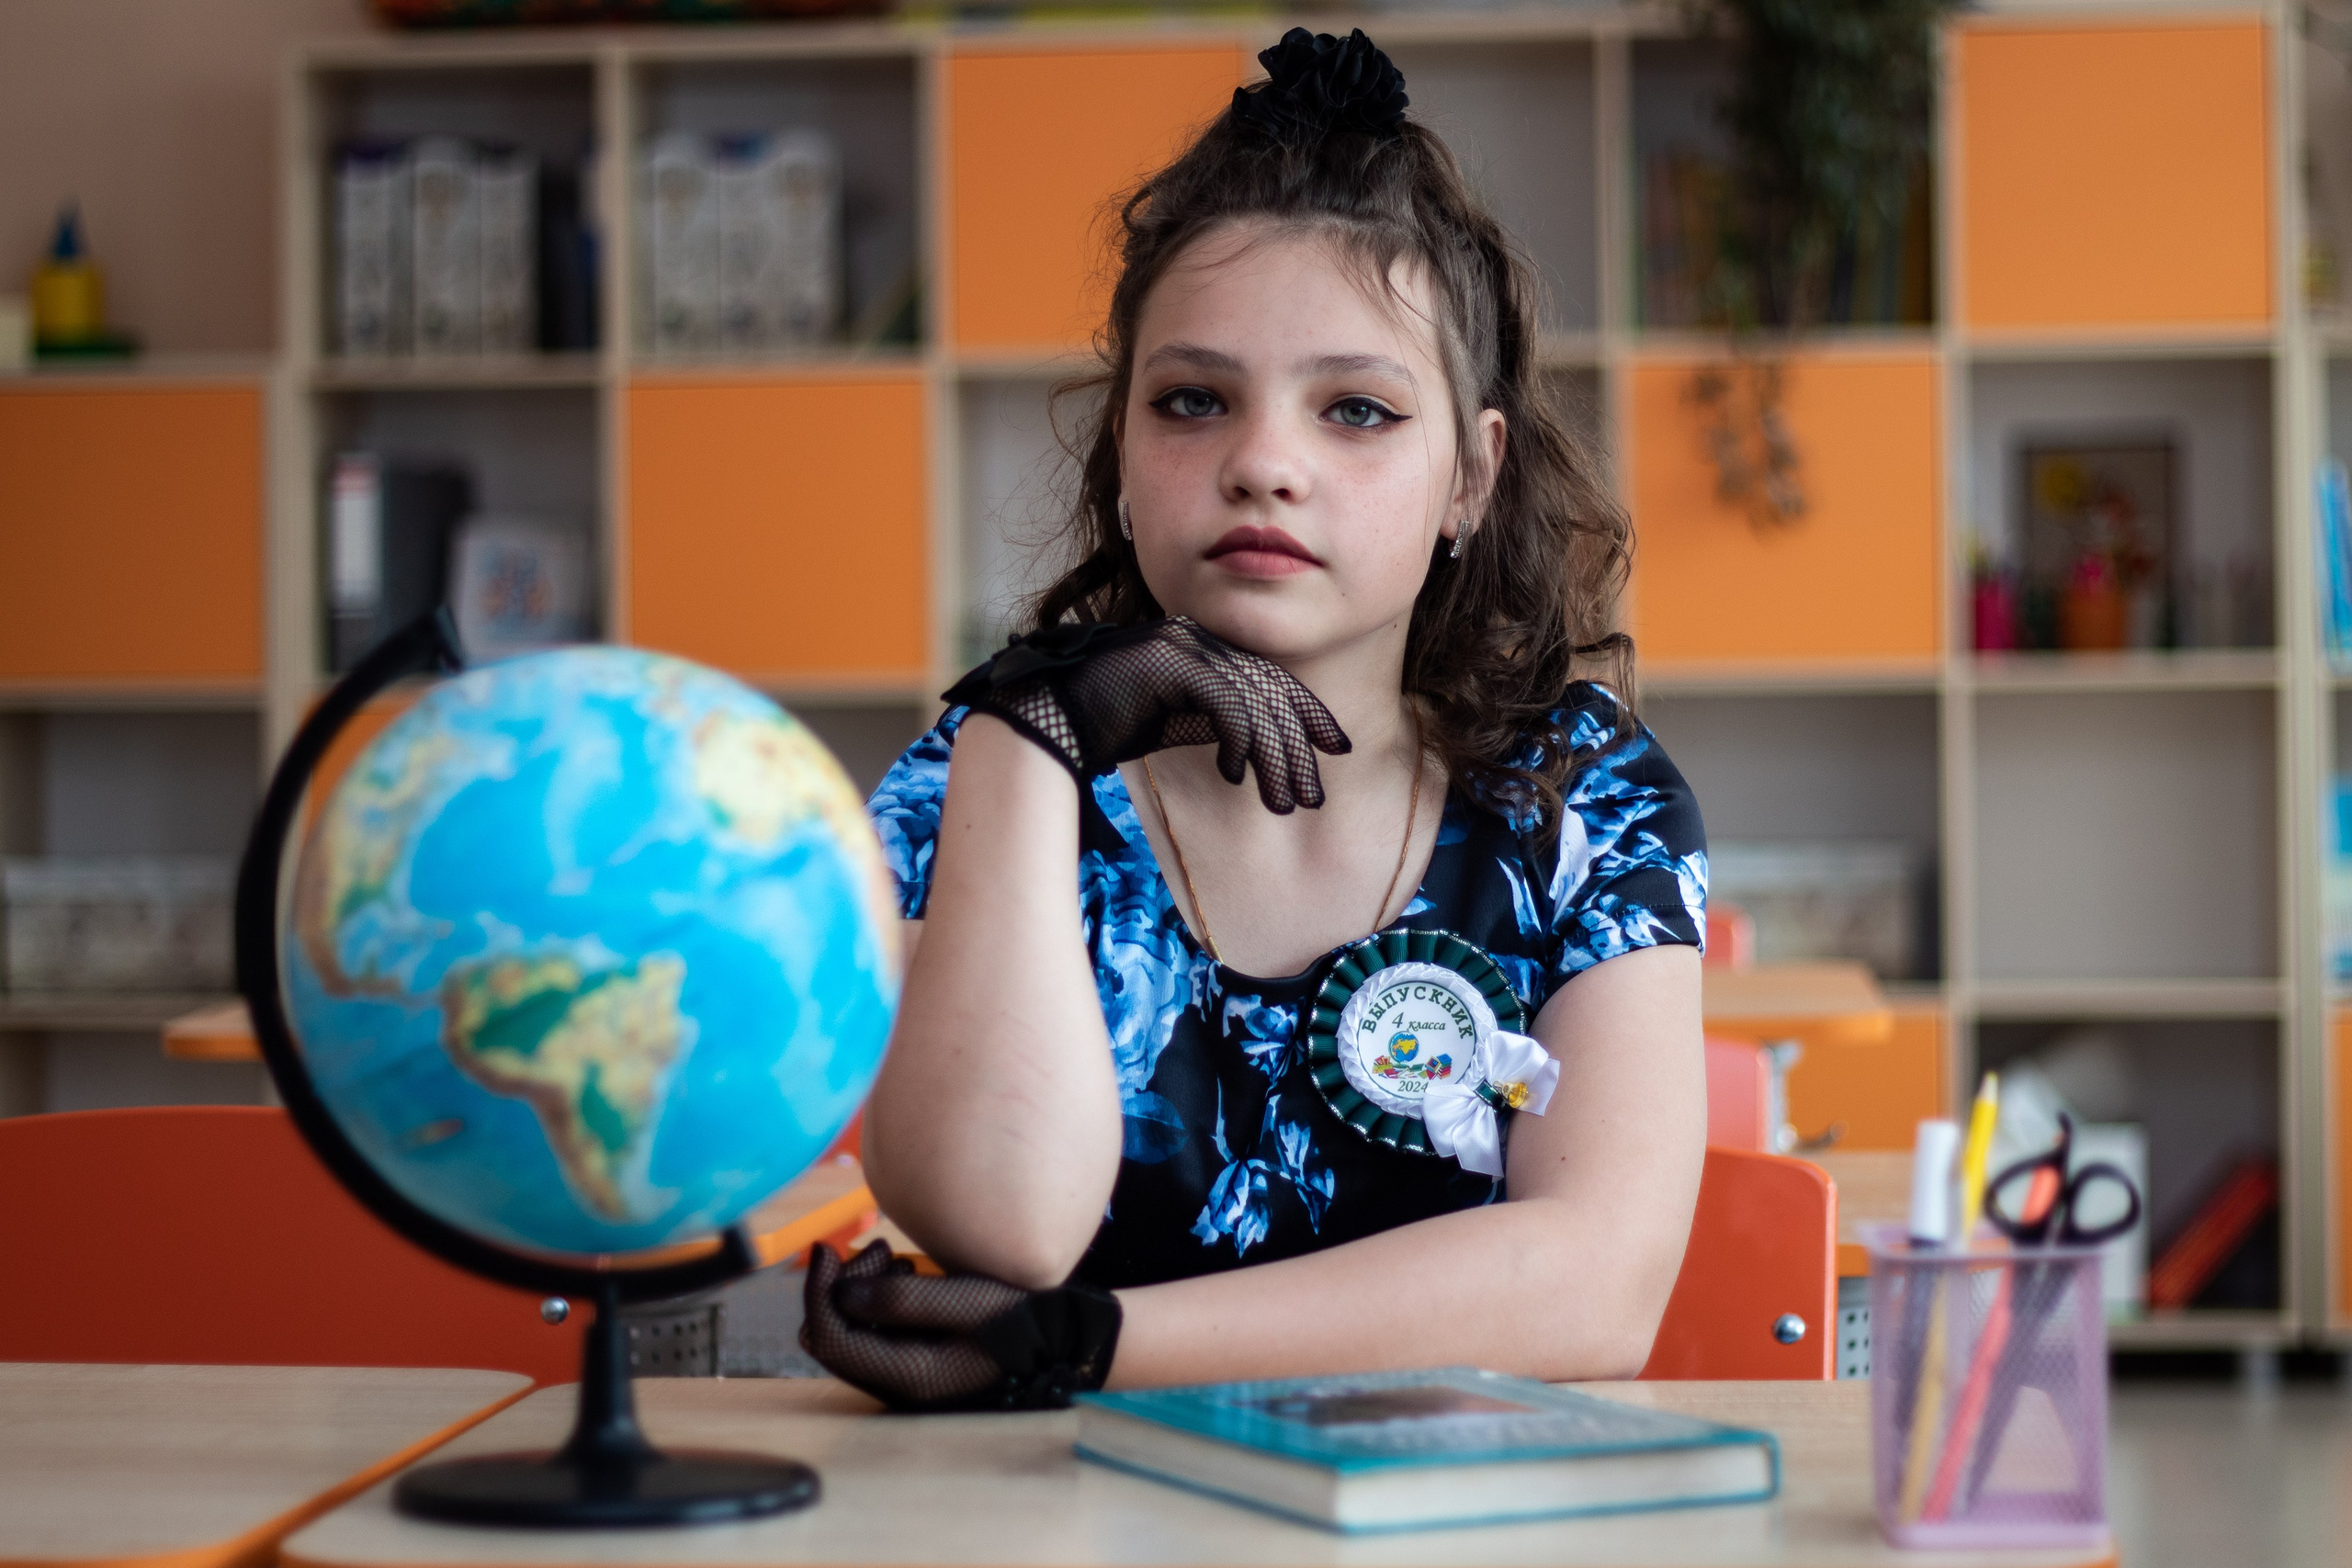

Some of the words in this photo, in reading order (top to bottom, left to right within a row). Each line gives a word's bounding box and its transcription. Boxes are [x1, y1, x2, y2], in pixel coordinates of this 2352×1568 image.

[1362, 986, 1473, 1039] ВЫПУСКНИК
[1392, 1012, 1404, 1029] 4
[1408, 1021, 1446, 1032] класса
[1397, 1080, 1429, 1092] 2024
